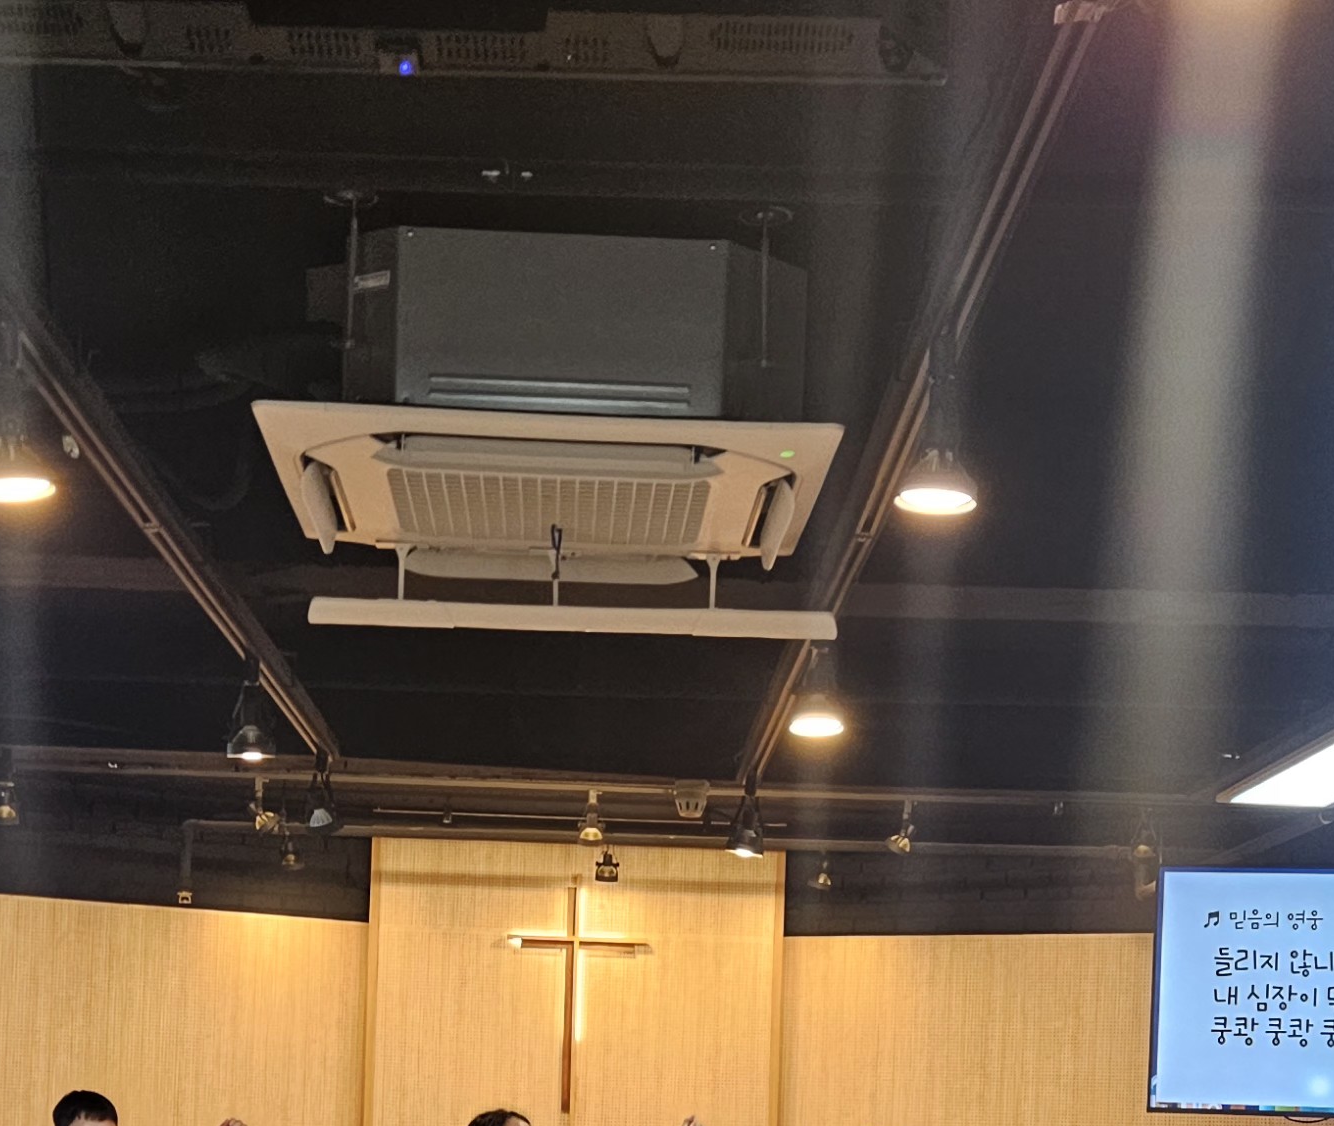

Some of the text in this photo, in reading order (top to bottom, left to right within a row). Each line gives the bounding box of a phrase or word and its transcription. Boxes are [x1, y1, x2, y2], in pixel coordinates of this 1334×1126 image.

[1229, 908, 1324, 931] 믿음의 영웅
[1213, 947, 1334, 978] 들리지 않니
[1213, 985, 1239, 1006] 내
[1246, 983, 1318, 1012] 심장이
[1210, 1016, 1260, 1047] 쿵쾅
[1264, 1017, 1314, 1048] 쿵쾅
